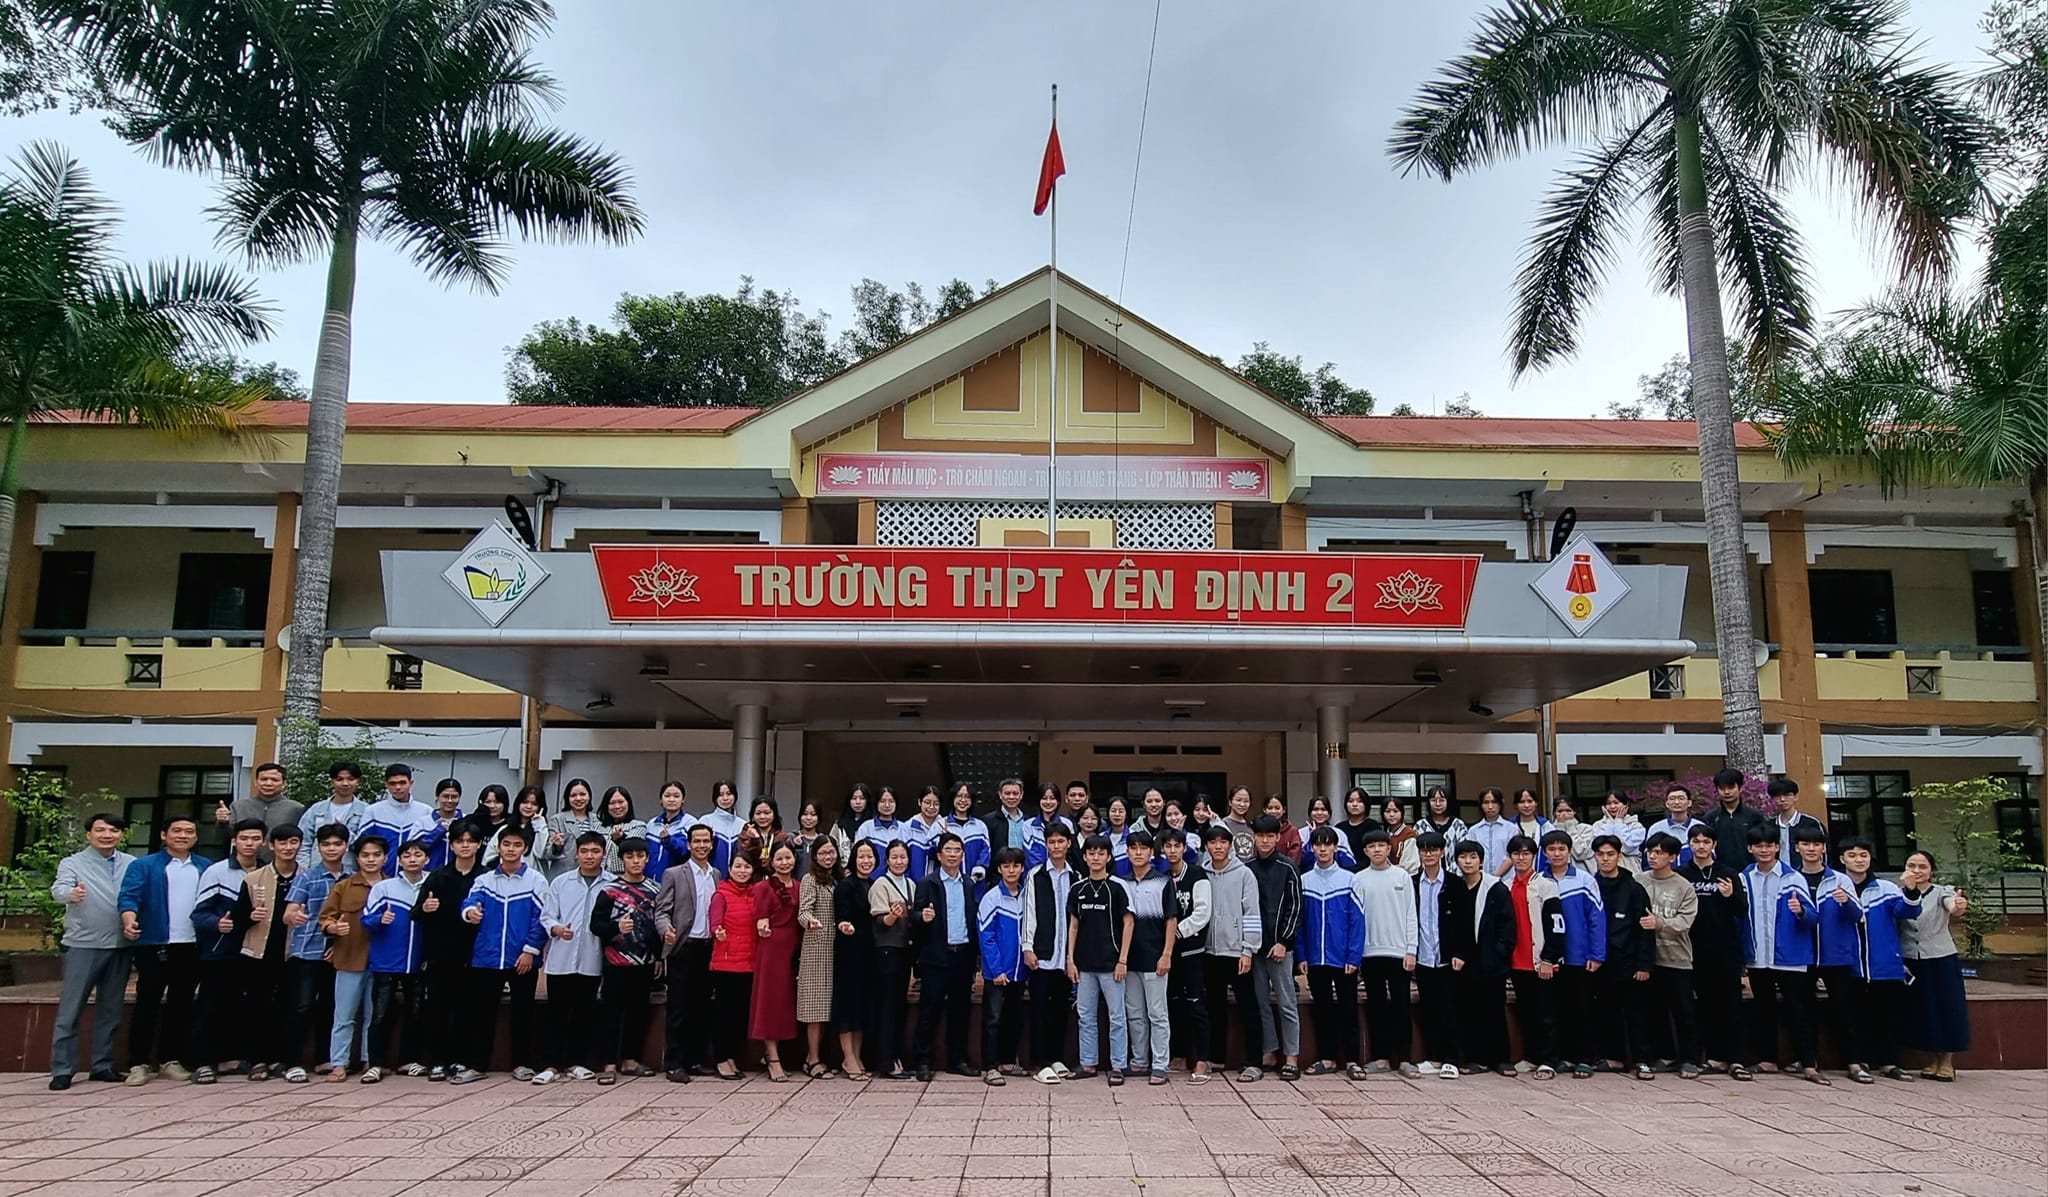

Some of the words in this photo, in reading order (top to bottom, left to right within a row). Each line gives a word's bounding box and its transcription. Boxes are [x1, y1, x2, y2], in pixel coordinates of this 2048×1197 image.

[915, 467, 937, 489] MỰC
[995, 468, 1026, 487] NGOAN
[1073, 470, 1105, 487] KHANG
[1145, 467, 1163, 488] LỚP
[734, 554, 928, 607] TRƯỜNG
[946, 566, 1064, 608] THPT
[1084, 559, 1174, 610] YÊN
[1194, 569, 1306, 619] ĐỊNH
[1325, 572, 1354, 612] 2
[1551, 913, 1566, 933] D
